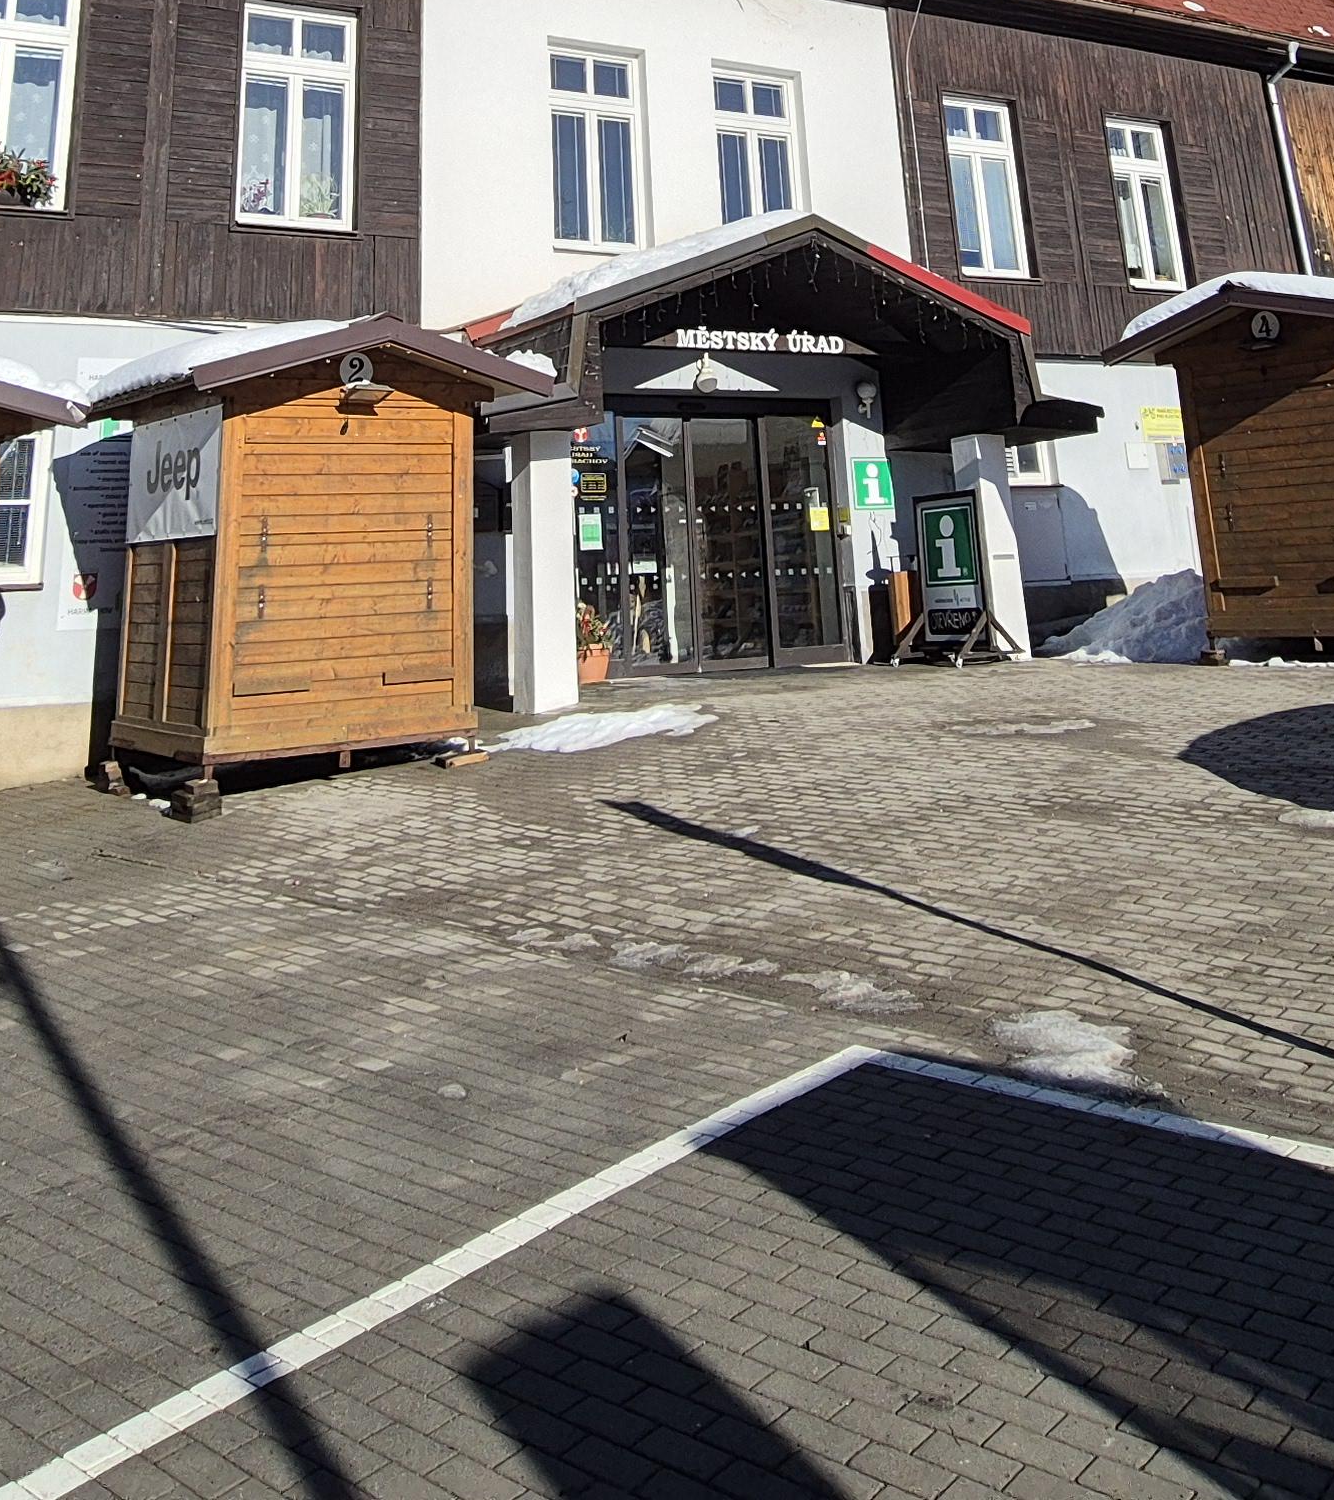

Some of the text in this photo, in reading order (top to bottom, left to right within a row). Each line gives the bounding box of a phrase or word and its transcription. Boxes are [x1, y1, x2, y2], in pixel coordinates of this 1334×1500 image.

[1258, 315, 1273, 337] 4
[676, 326, 844, 354] MĚSTSKÝ ÚŘAD
[348, 357, 365, 383] 2
[147, 440, 201, 501] Jeep
